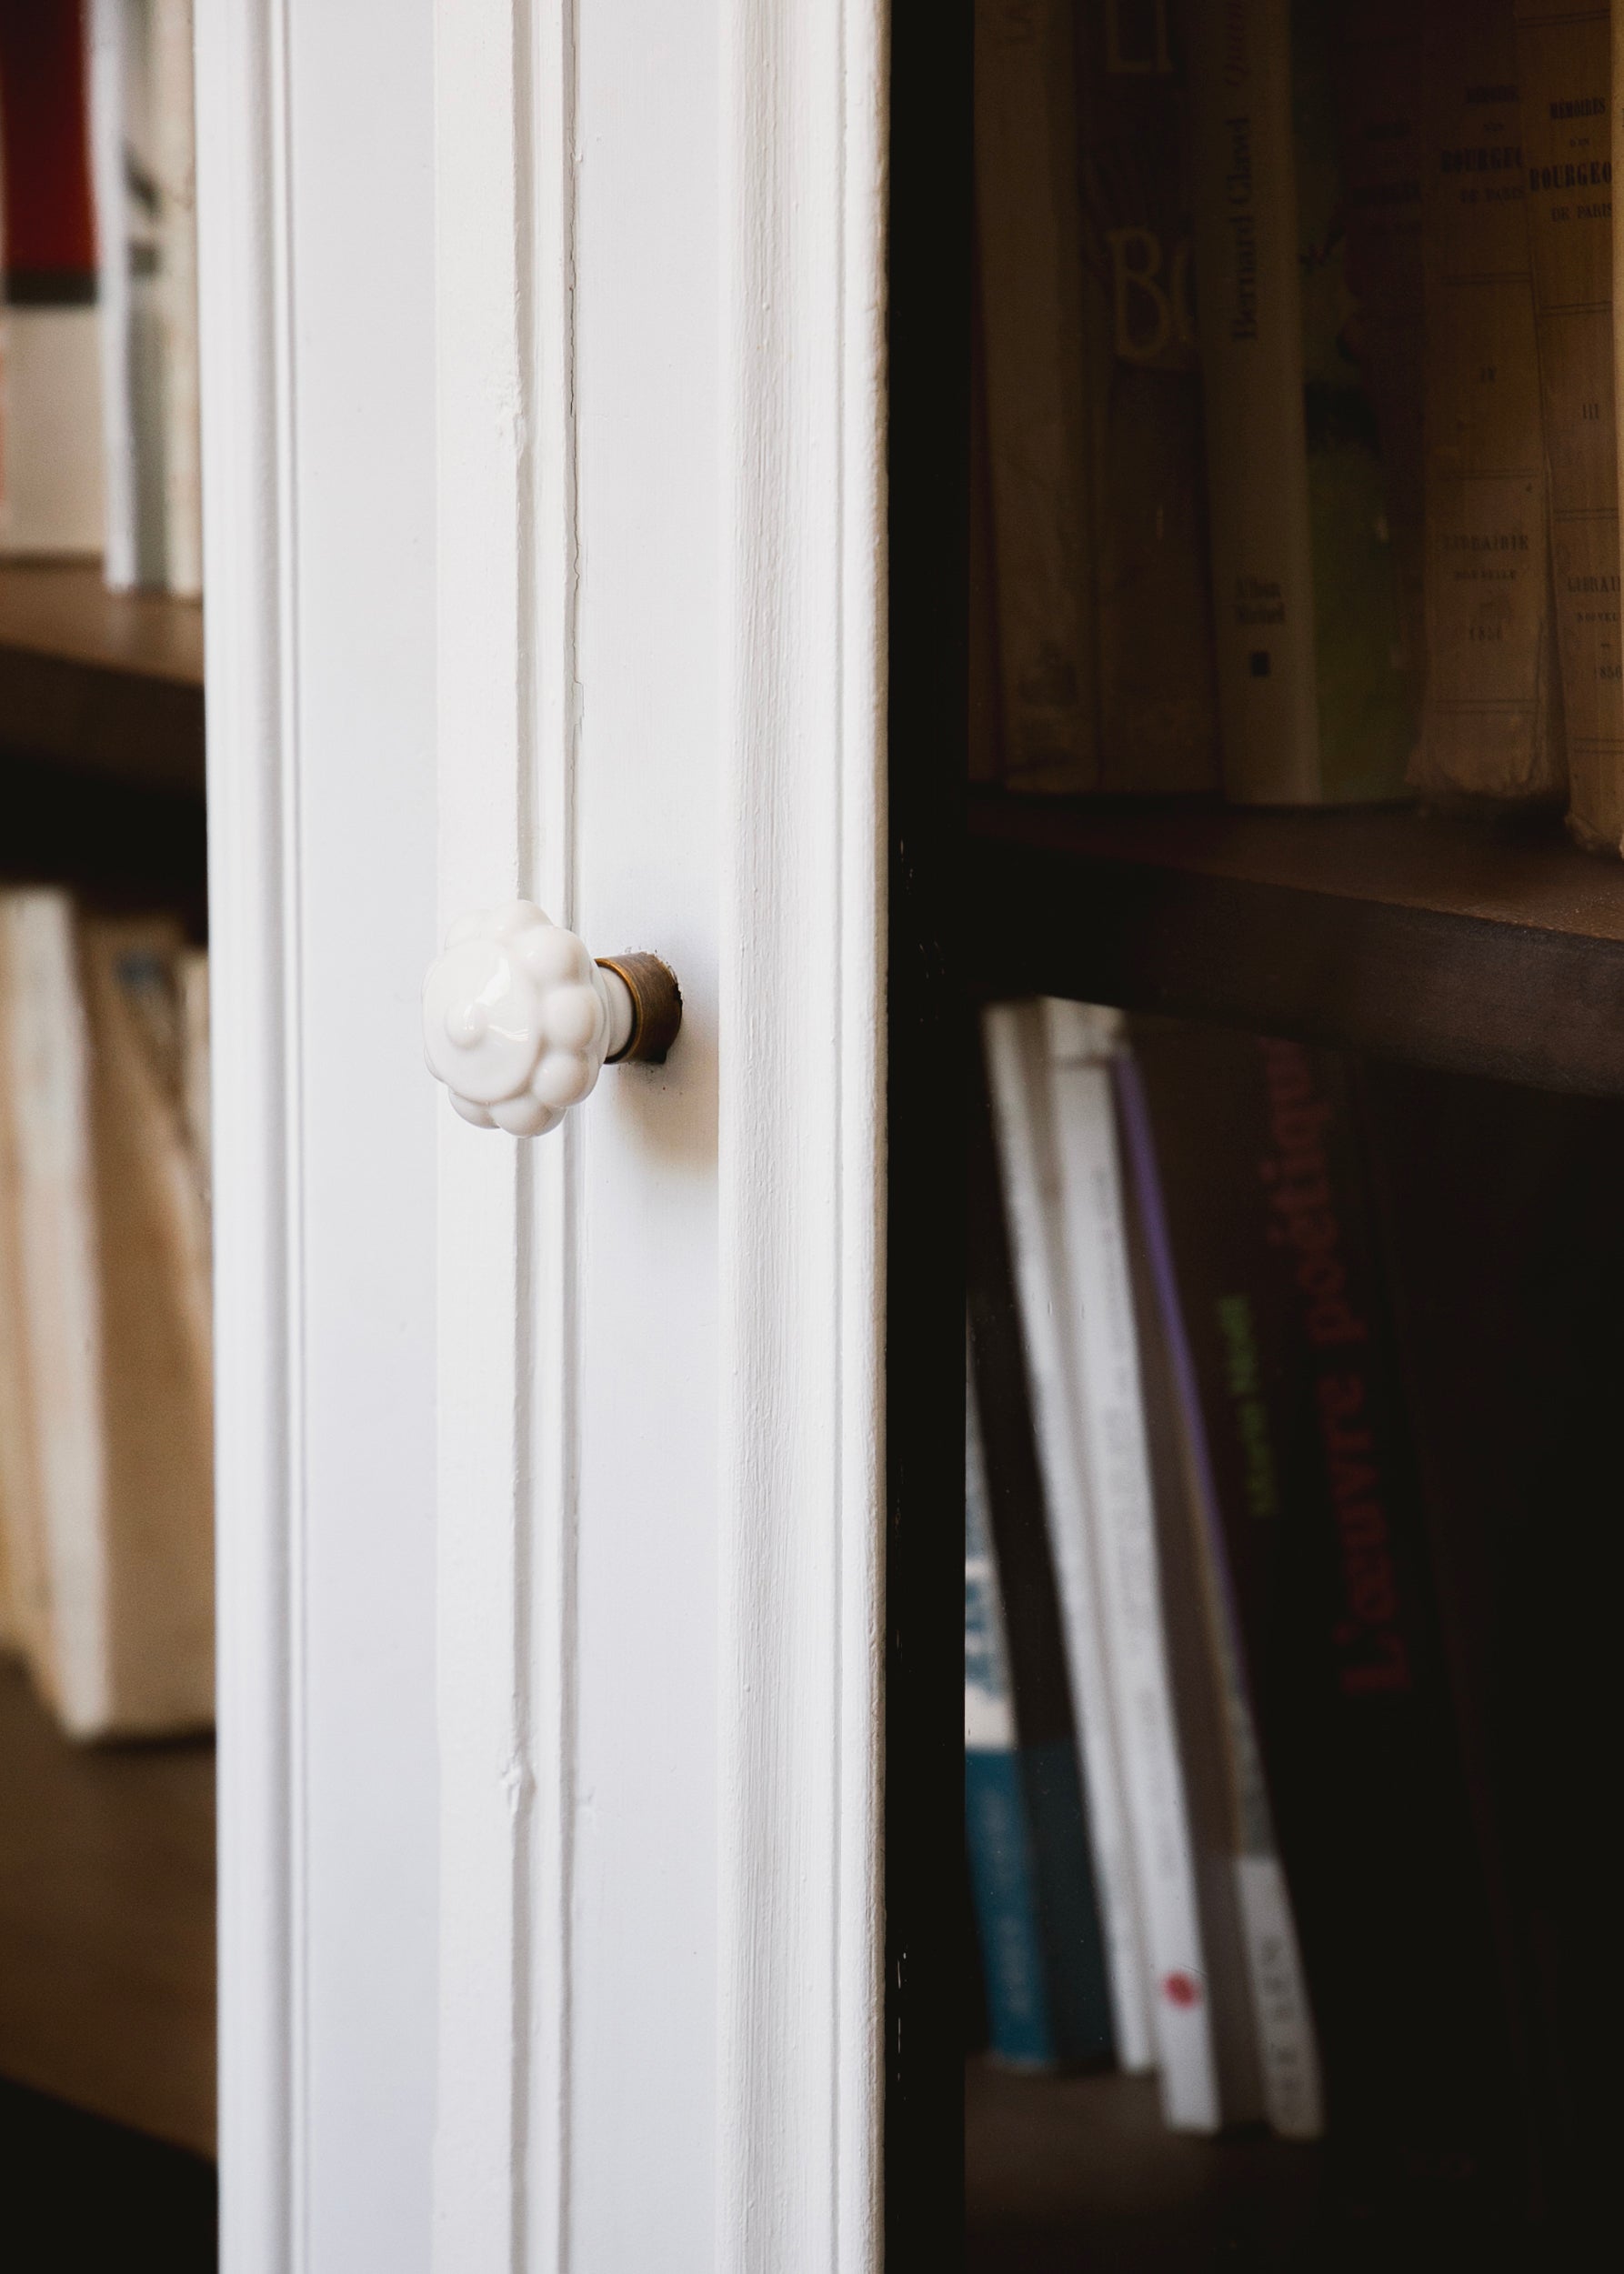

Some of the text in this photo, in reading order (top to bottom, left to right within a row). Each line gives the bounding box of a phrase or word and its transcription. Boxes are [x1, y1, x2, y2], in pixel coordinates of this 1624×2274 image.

[1223, 117, 1252, 205] Clavel
[1551, 206, 1570, 223] DE
[1230, 214, 1258, 341] Bernard
